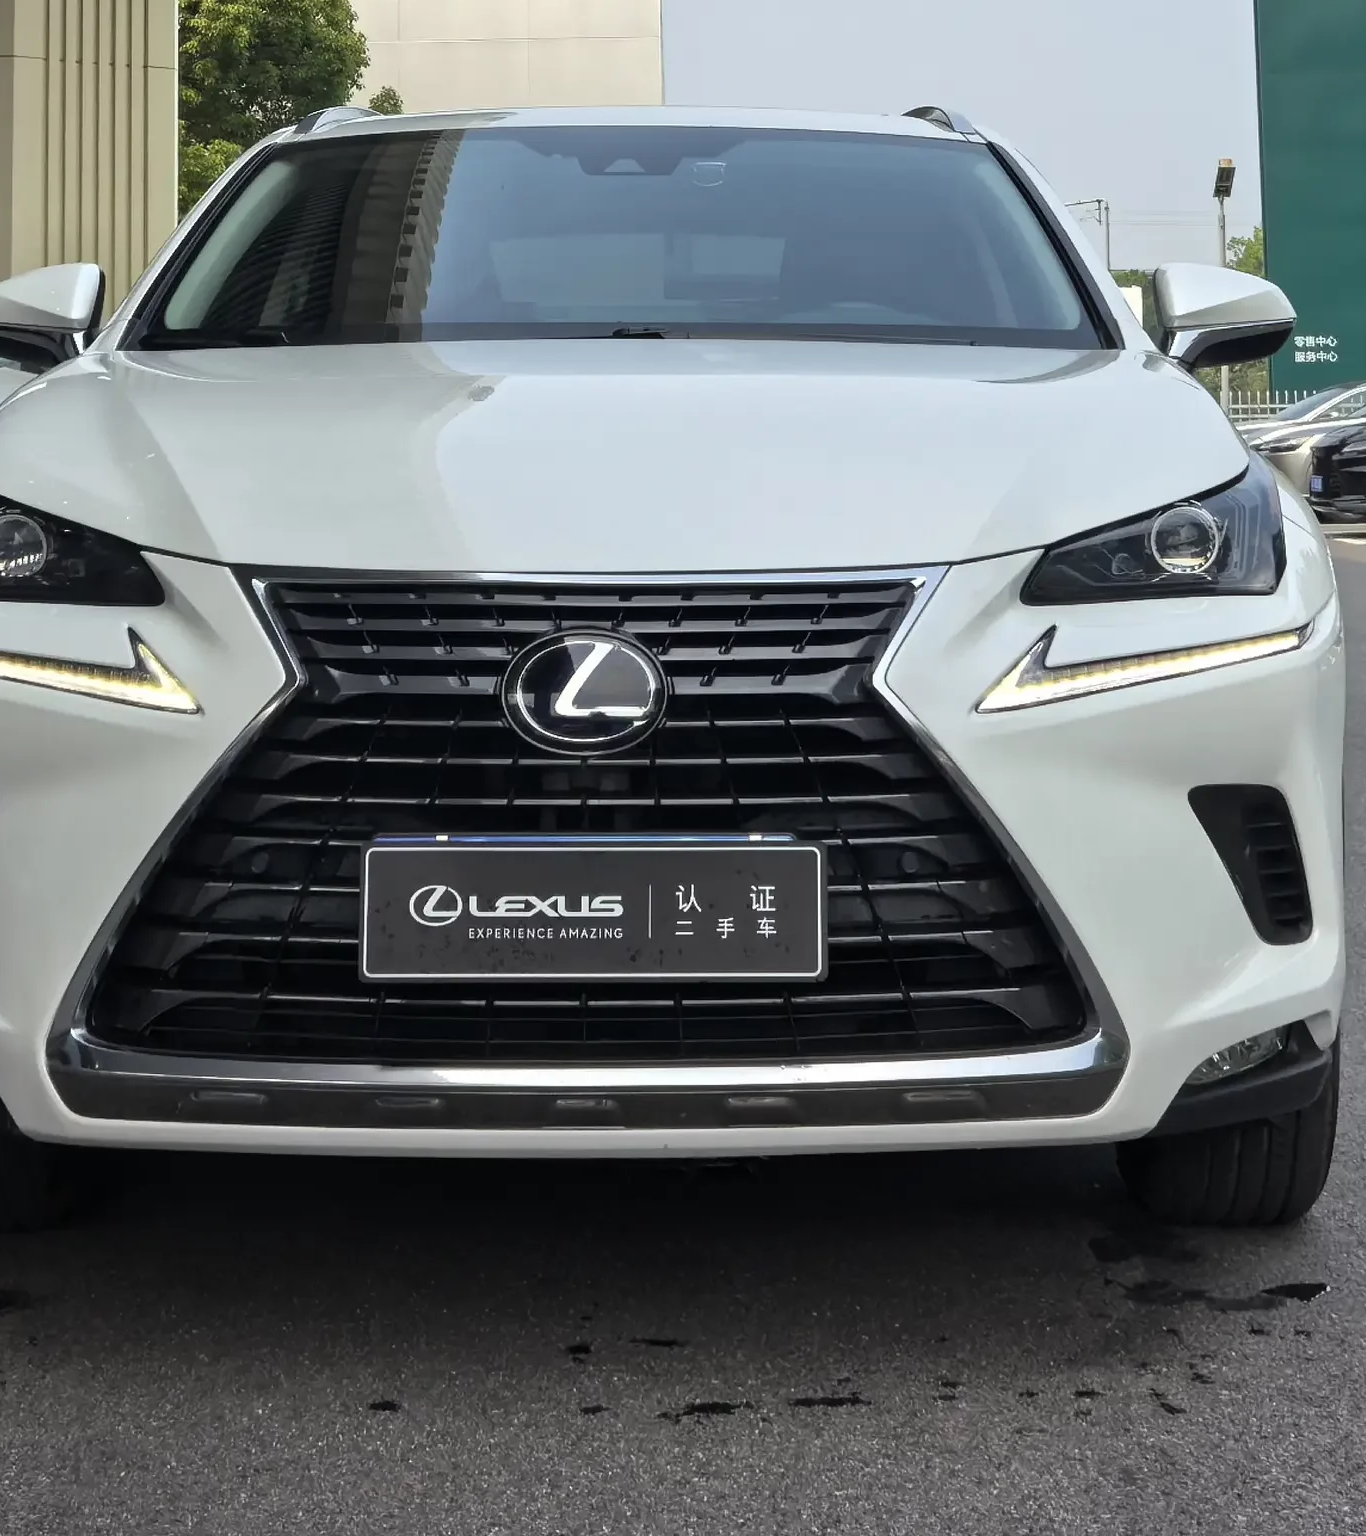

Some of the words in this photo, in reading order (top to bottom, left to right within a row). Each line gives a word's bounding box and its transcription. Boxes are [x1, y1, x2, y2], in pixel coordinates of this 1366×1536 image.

[1293, 335, 1338, 348] 零售中心
[1294, 350, 1338, 363] 服务中心
[468, 895, 624, 918] LEXUS
[468, 927, 554, 939] EXPERIENCE
[559, 927, 623, 939] AMAZING
